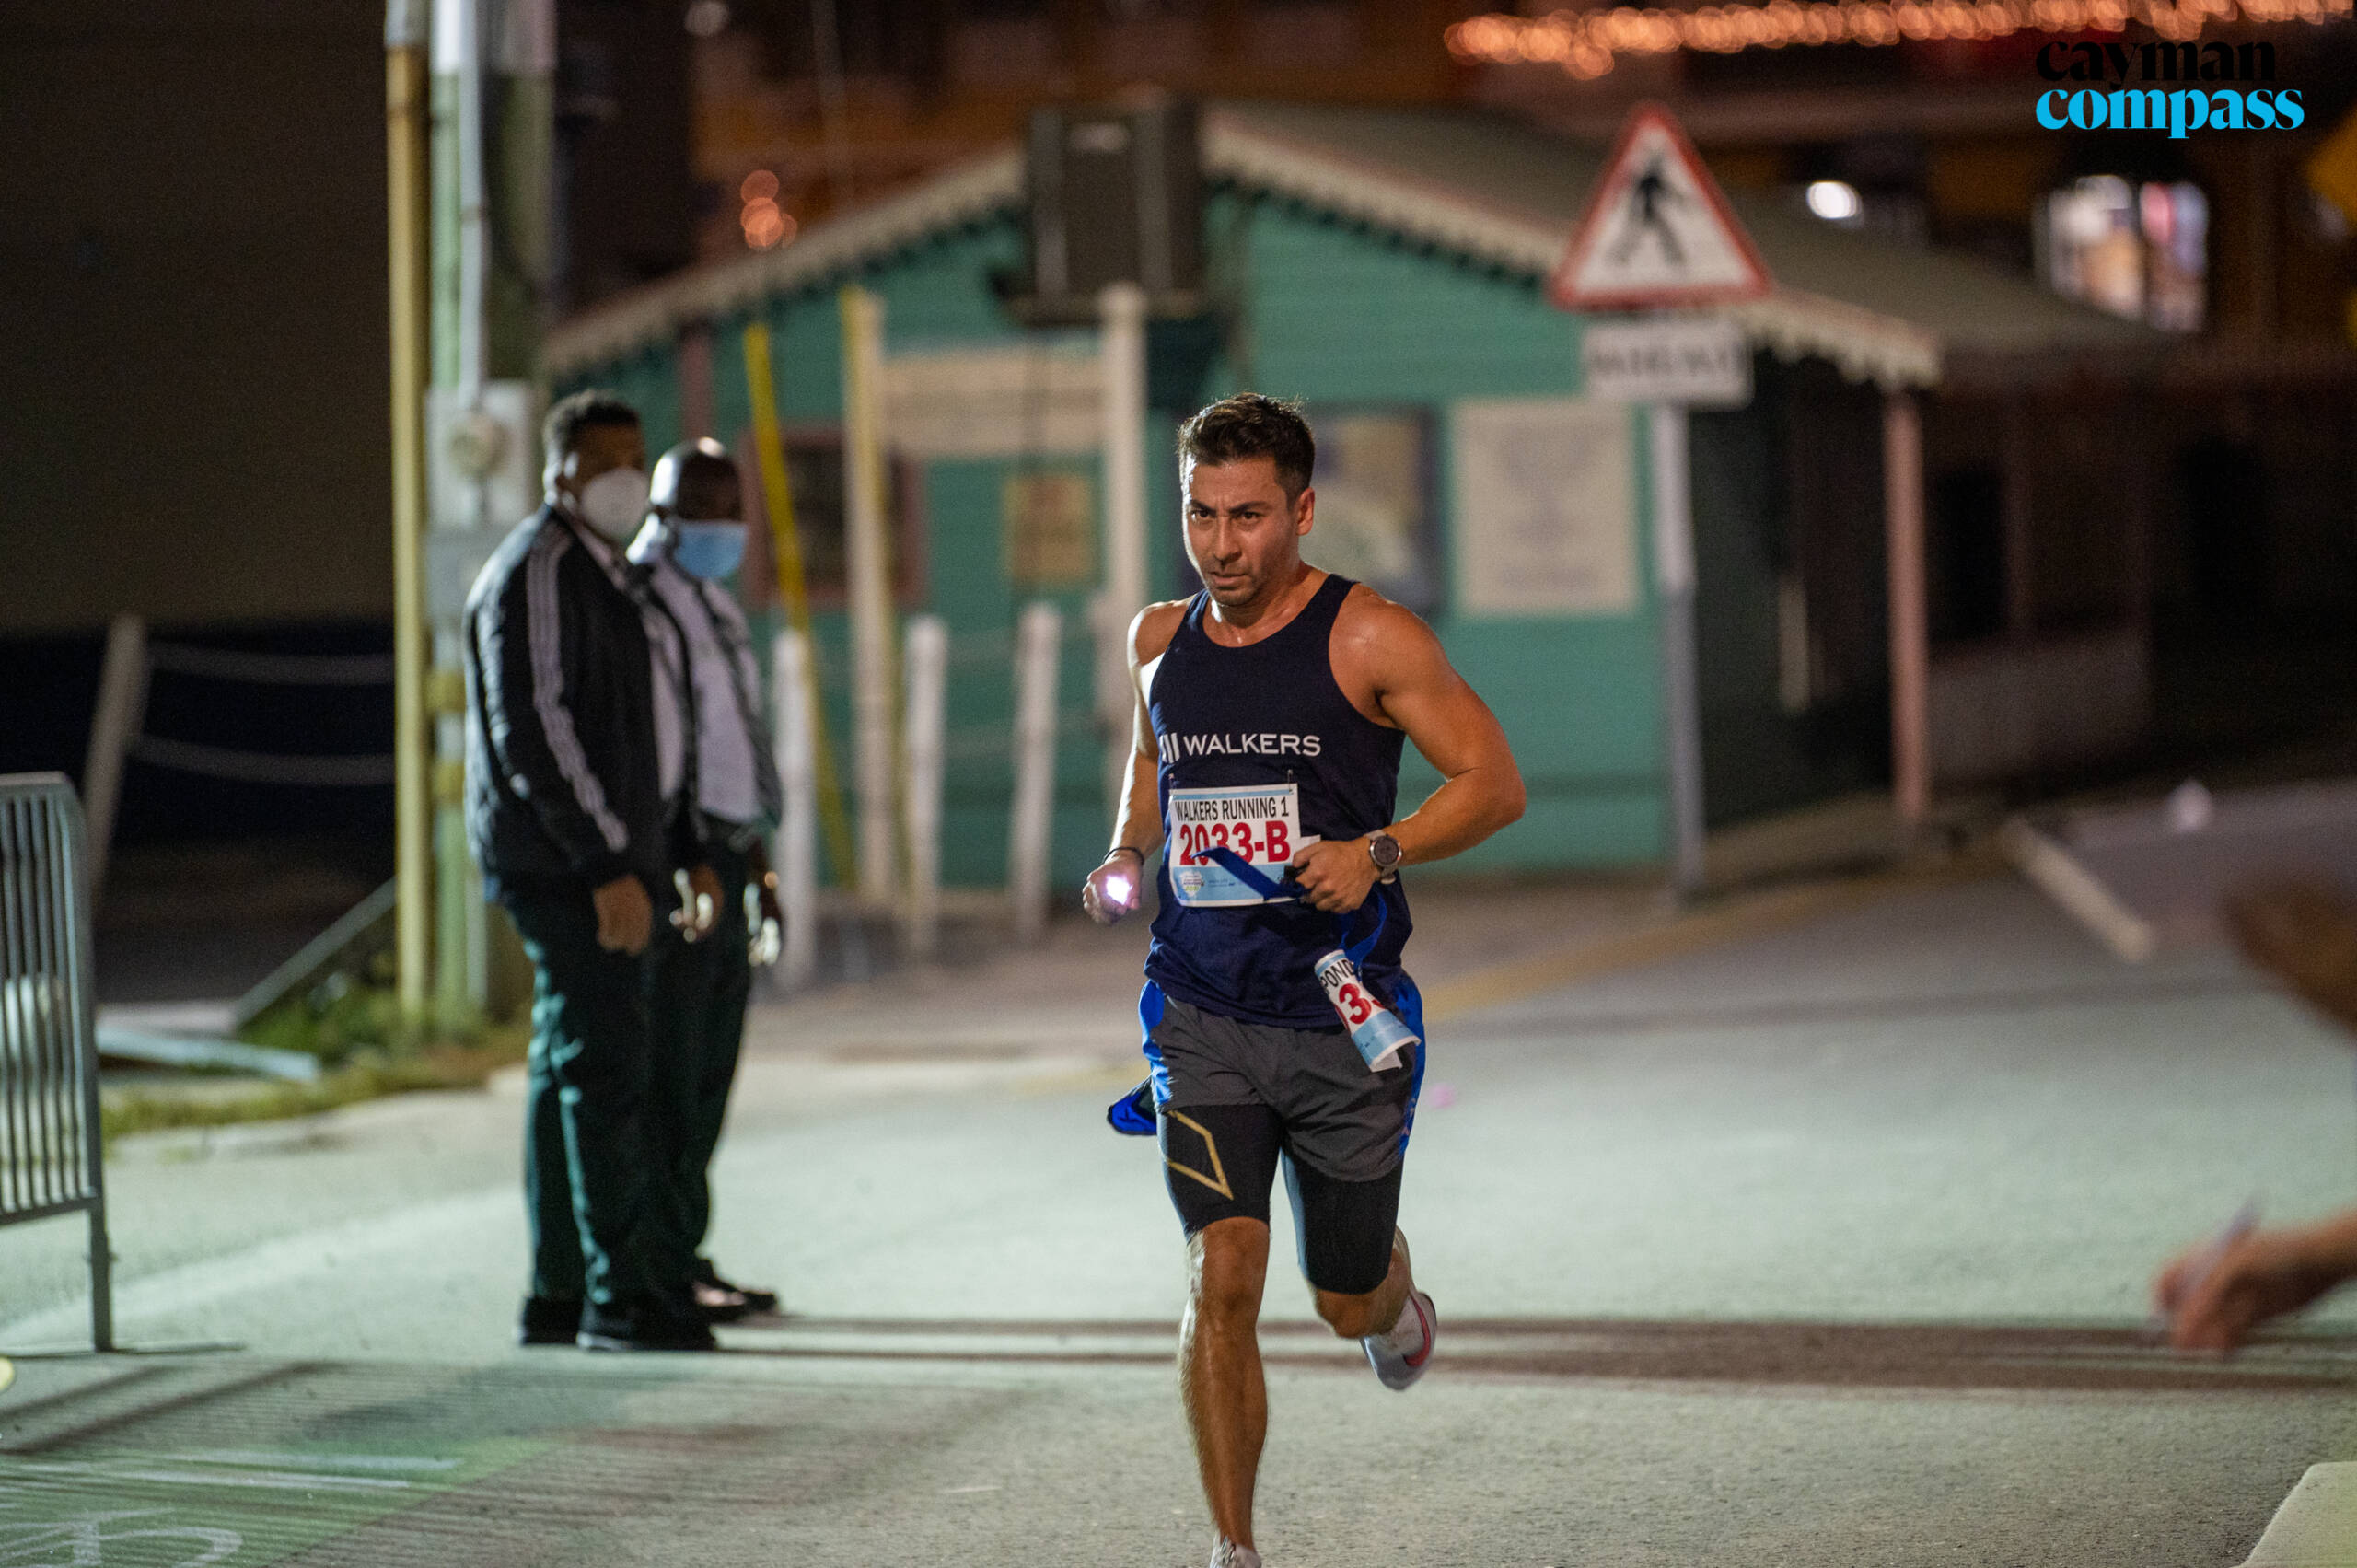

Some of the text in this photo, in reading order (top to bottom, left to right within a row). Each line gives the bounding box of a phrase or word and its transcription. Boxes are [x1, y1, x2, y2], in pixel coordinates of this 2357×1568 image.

[1183, 733, 1322, 757] WALKERS
[1175, 796, 1289, 821] WALKERS RUNNING 1
